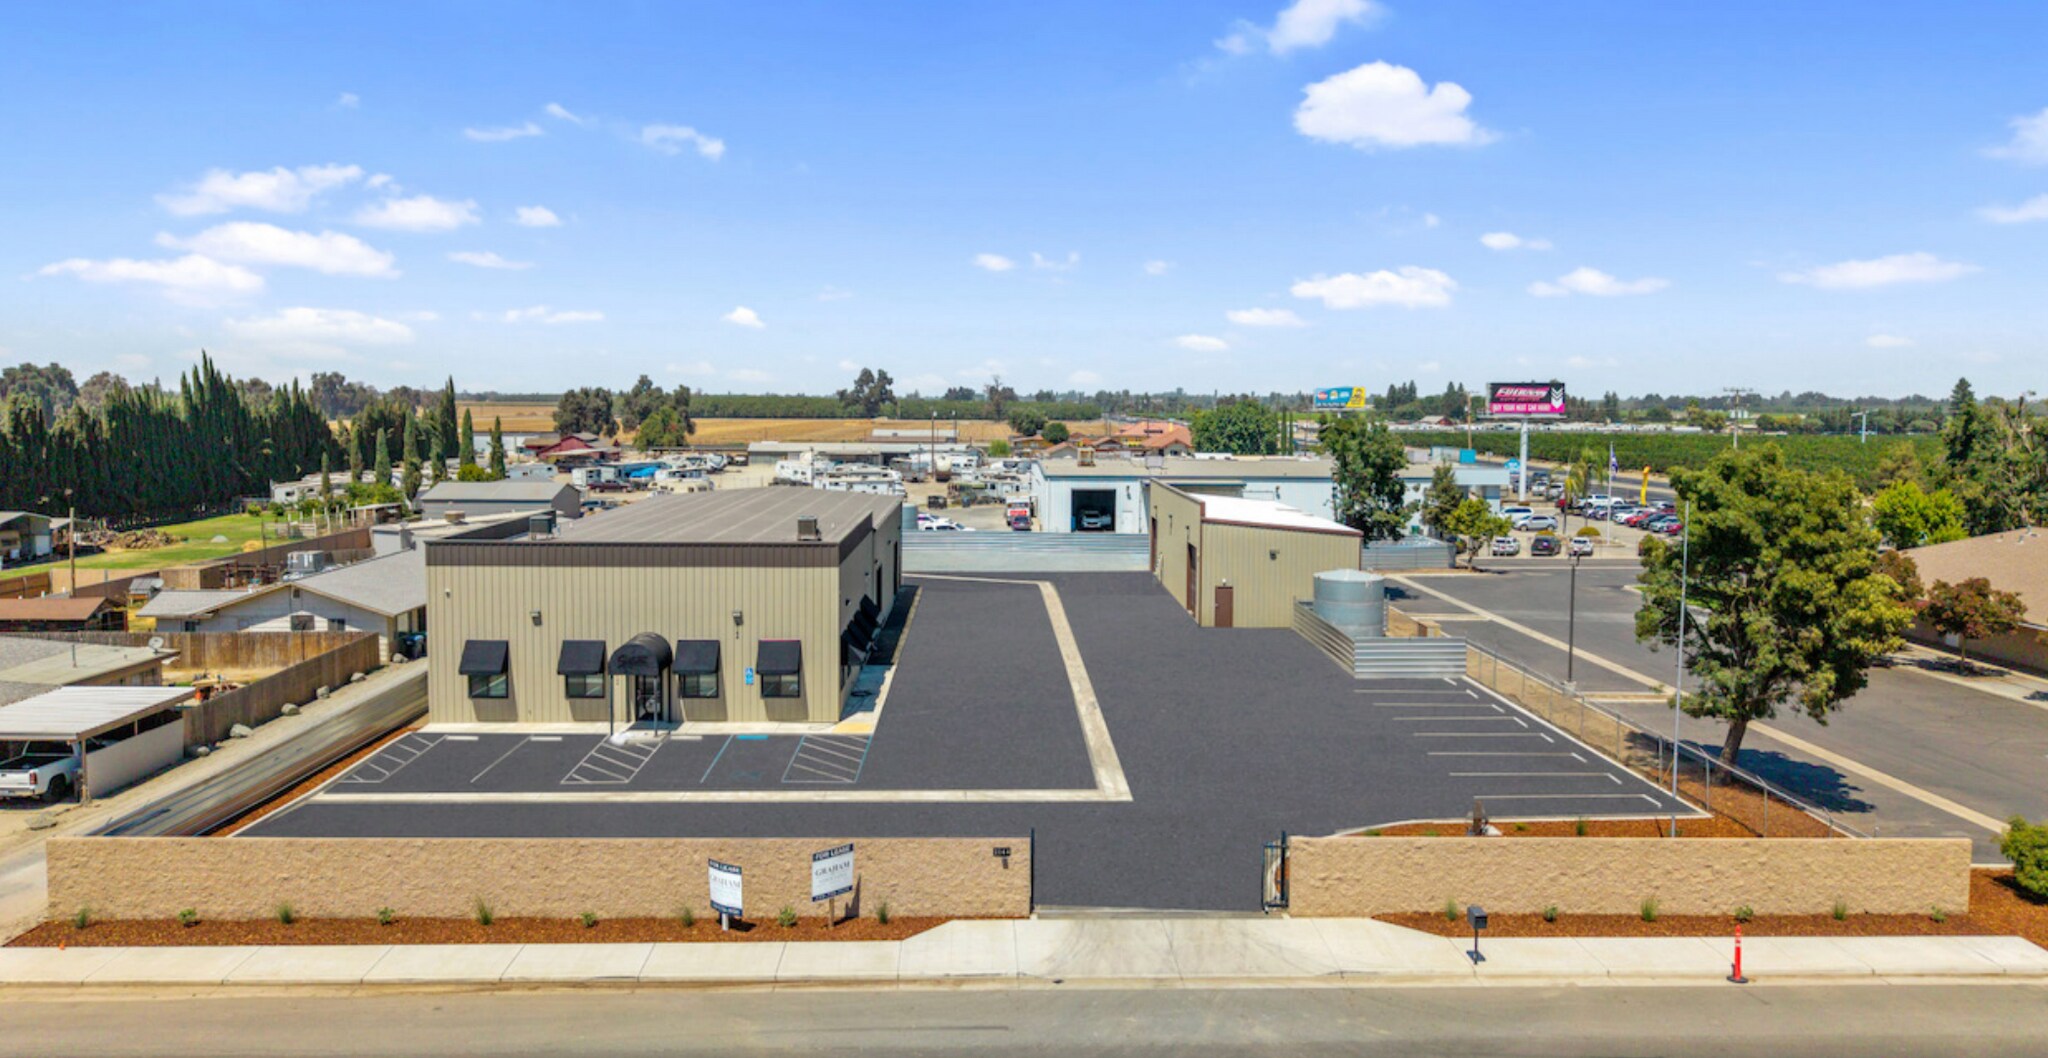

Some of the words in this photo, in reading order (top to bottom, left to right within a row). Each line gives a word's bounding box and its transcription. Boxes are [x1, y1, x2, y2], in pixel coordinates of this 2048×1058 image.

[815, 850, 830, 860] FOR
[831, 845, 850, 857] LEASE
[815, 861, 850, 876] GRAHAM
